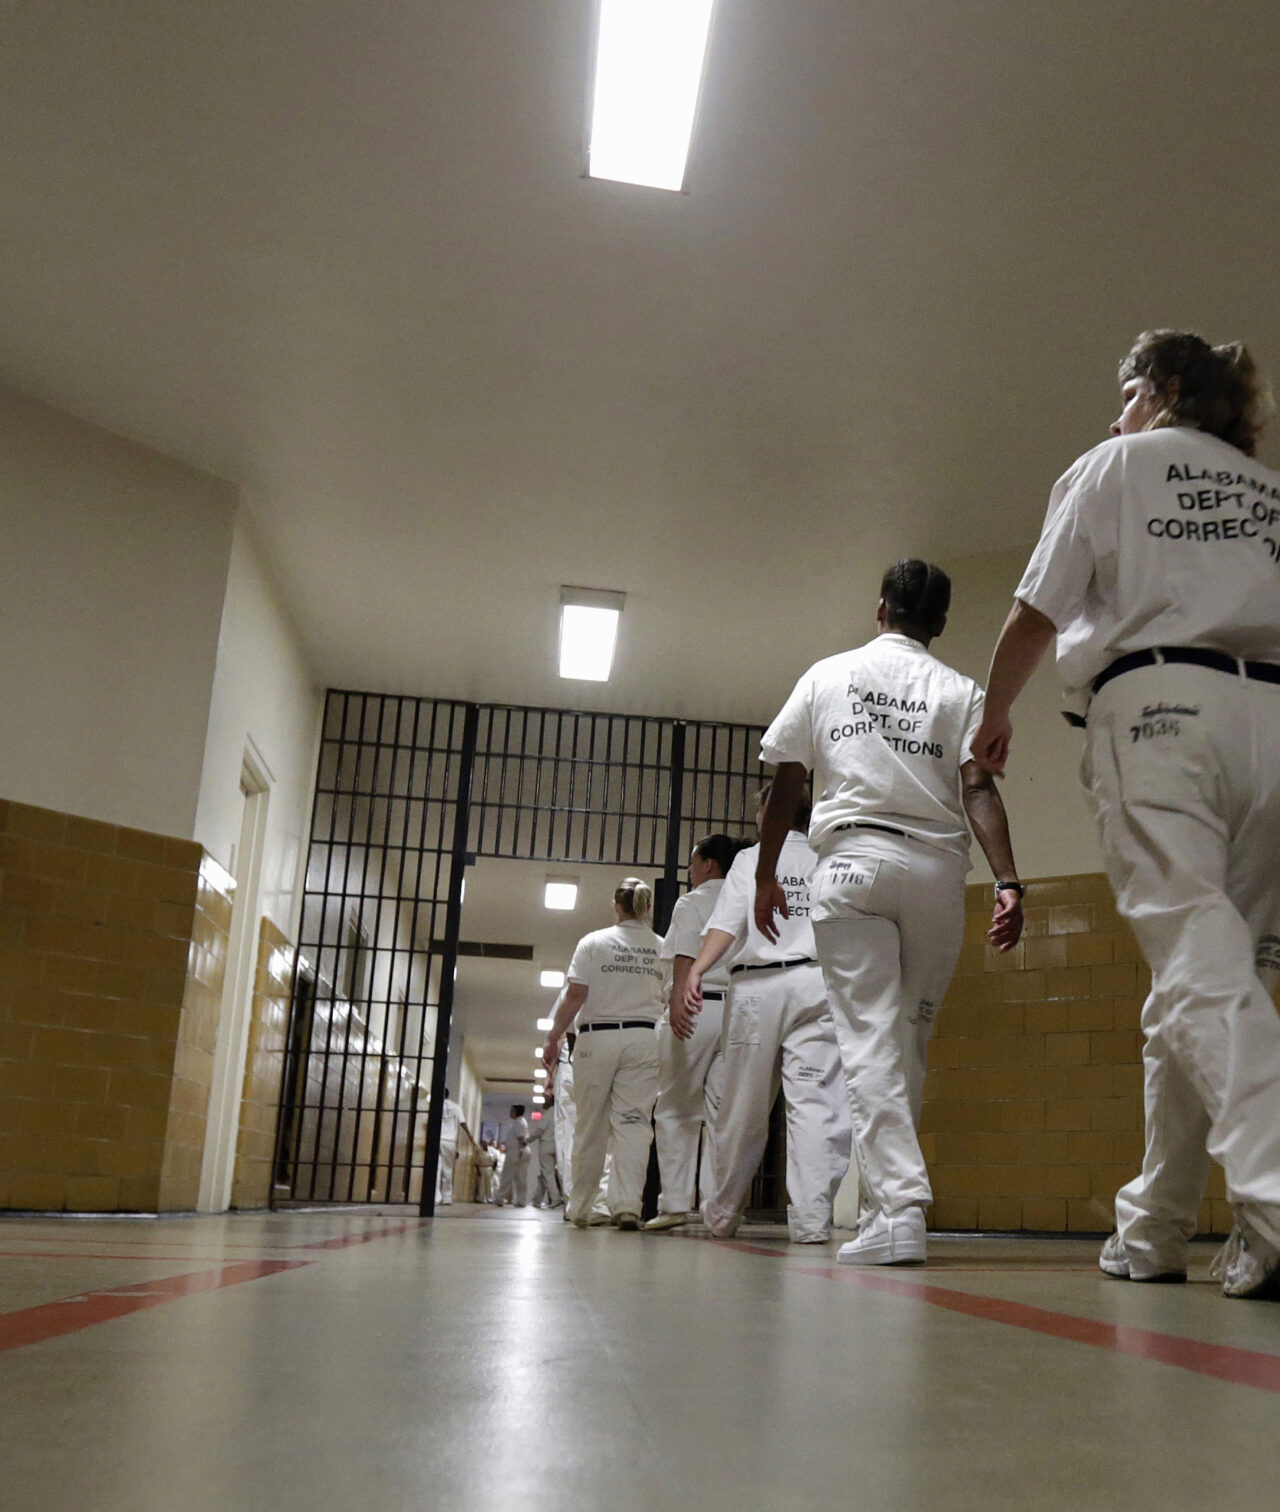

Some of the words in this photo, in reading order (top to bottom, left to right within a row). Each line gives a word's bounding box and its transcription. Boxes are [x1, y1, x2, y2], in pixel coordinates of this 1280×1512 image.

[852, 702, 891, 729] DPT.
[898, 718, 922, 733] OF
[830, 721, 943, 759] CORTIONS
[775, 874, 807, 887] LABA
